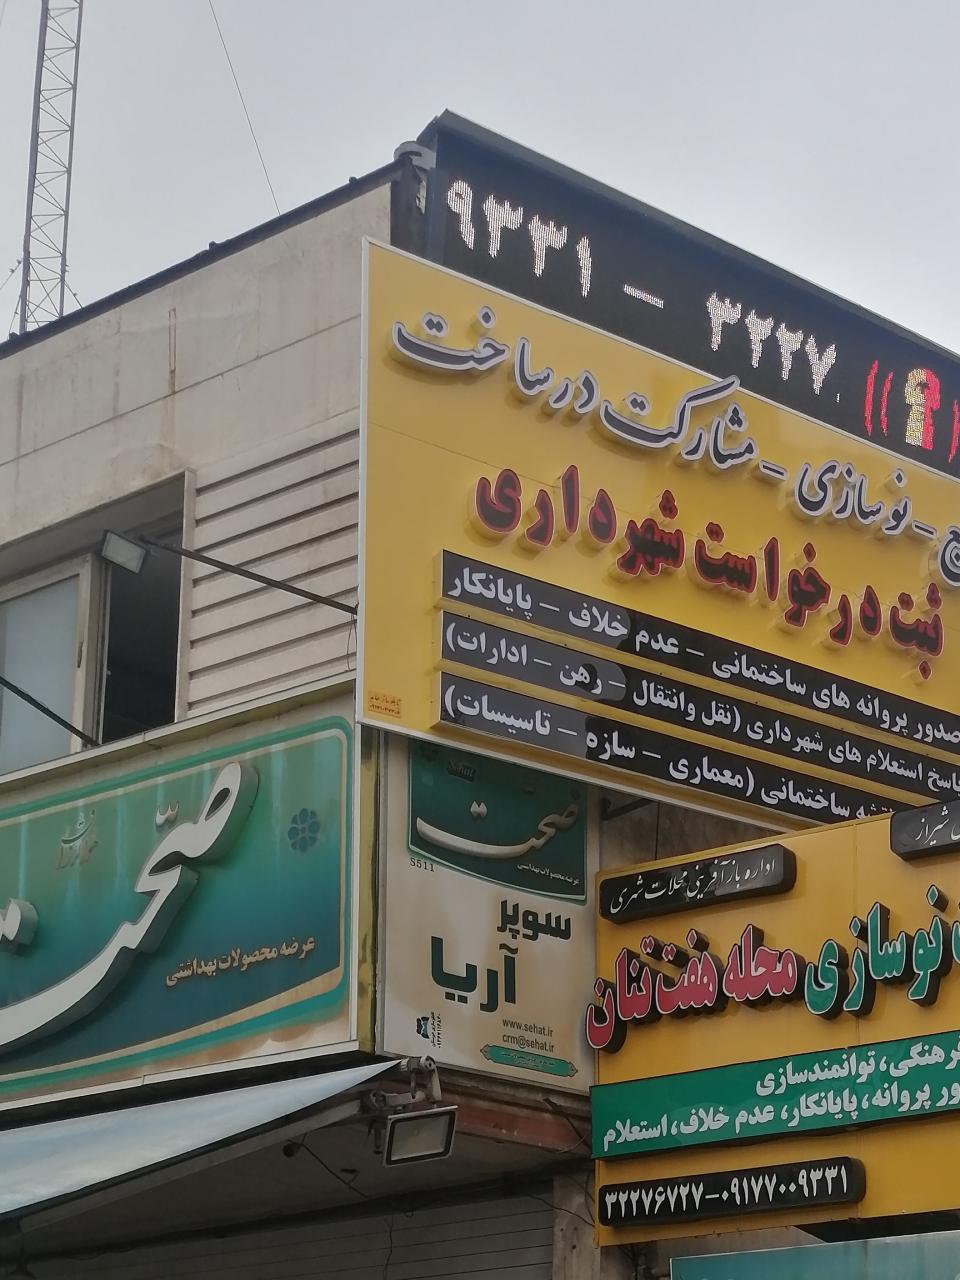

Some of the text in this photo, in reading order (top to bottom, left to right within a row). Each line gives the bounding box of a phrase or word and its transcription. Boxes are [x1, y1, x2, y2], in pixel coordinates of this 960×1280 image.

[600, 374, 759, 470] مشارکت
[693, 521, 882, 647] درخواست
[568, 602, 628, 638] خلاف
[889, 582, 945, 681] ثبت
[635, 631, 680, 655] عدم
[559, 663, 603, 695] رهن
[712, 650, 806, 695] ساختمانی
[812, 683, 851, 710] های
[856, 696, 909, 735] پروانه
[586, 729, 636, 761] سازه
[828, 740, 862, 765] های
[866, 749, 924, 782] استعلام
[760, 777, 852, 818] ساختمانی
[416, 800, 580, 859] صحت
[915, 805, 950, 846] شیراز
[410, 858, 435, 872] S511
[610, 875, 645, 914] شهری
[645, 870, 688, 899] محلات
[497, 899, 572, 941] سوپر
[166, 935, 316, 987] عرضه محصولات بهداشتی
[430, 935, 519, 1013] آریا
[722, 923, 798, 1002] محله
[502, 1018, 554, 1038] www.sehat.ir
[502, 1034, 555, 1053] crm@sehat.ir
[603, 1114, 669, 1152] استعلام
[735, 1104, 775, 1134] عدم
